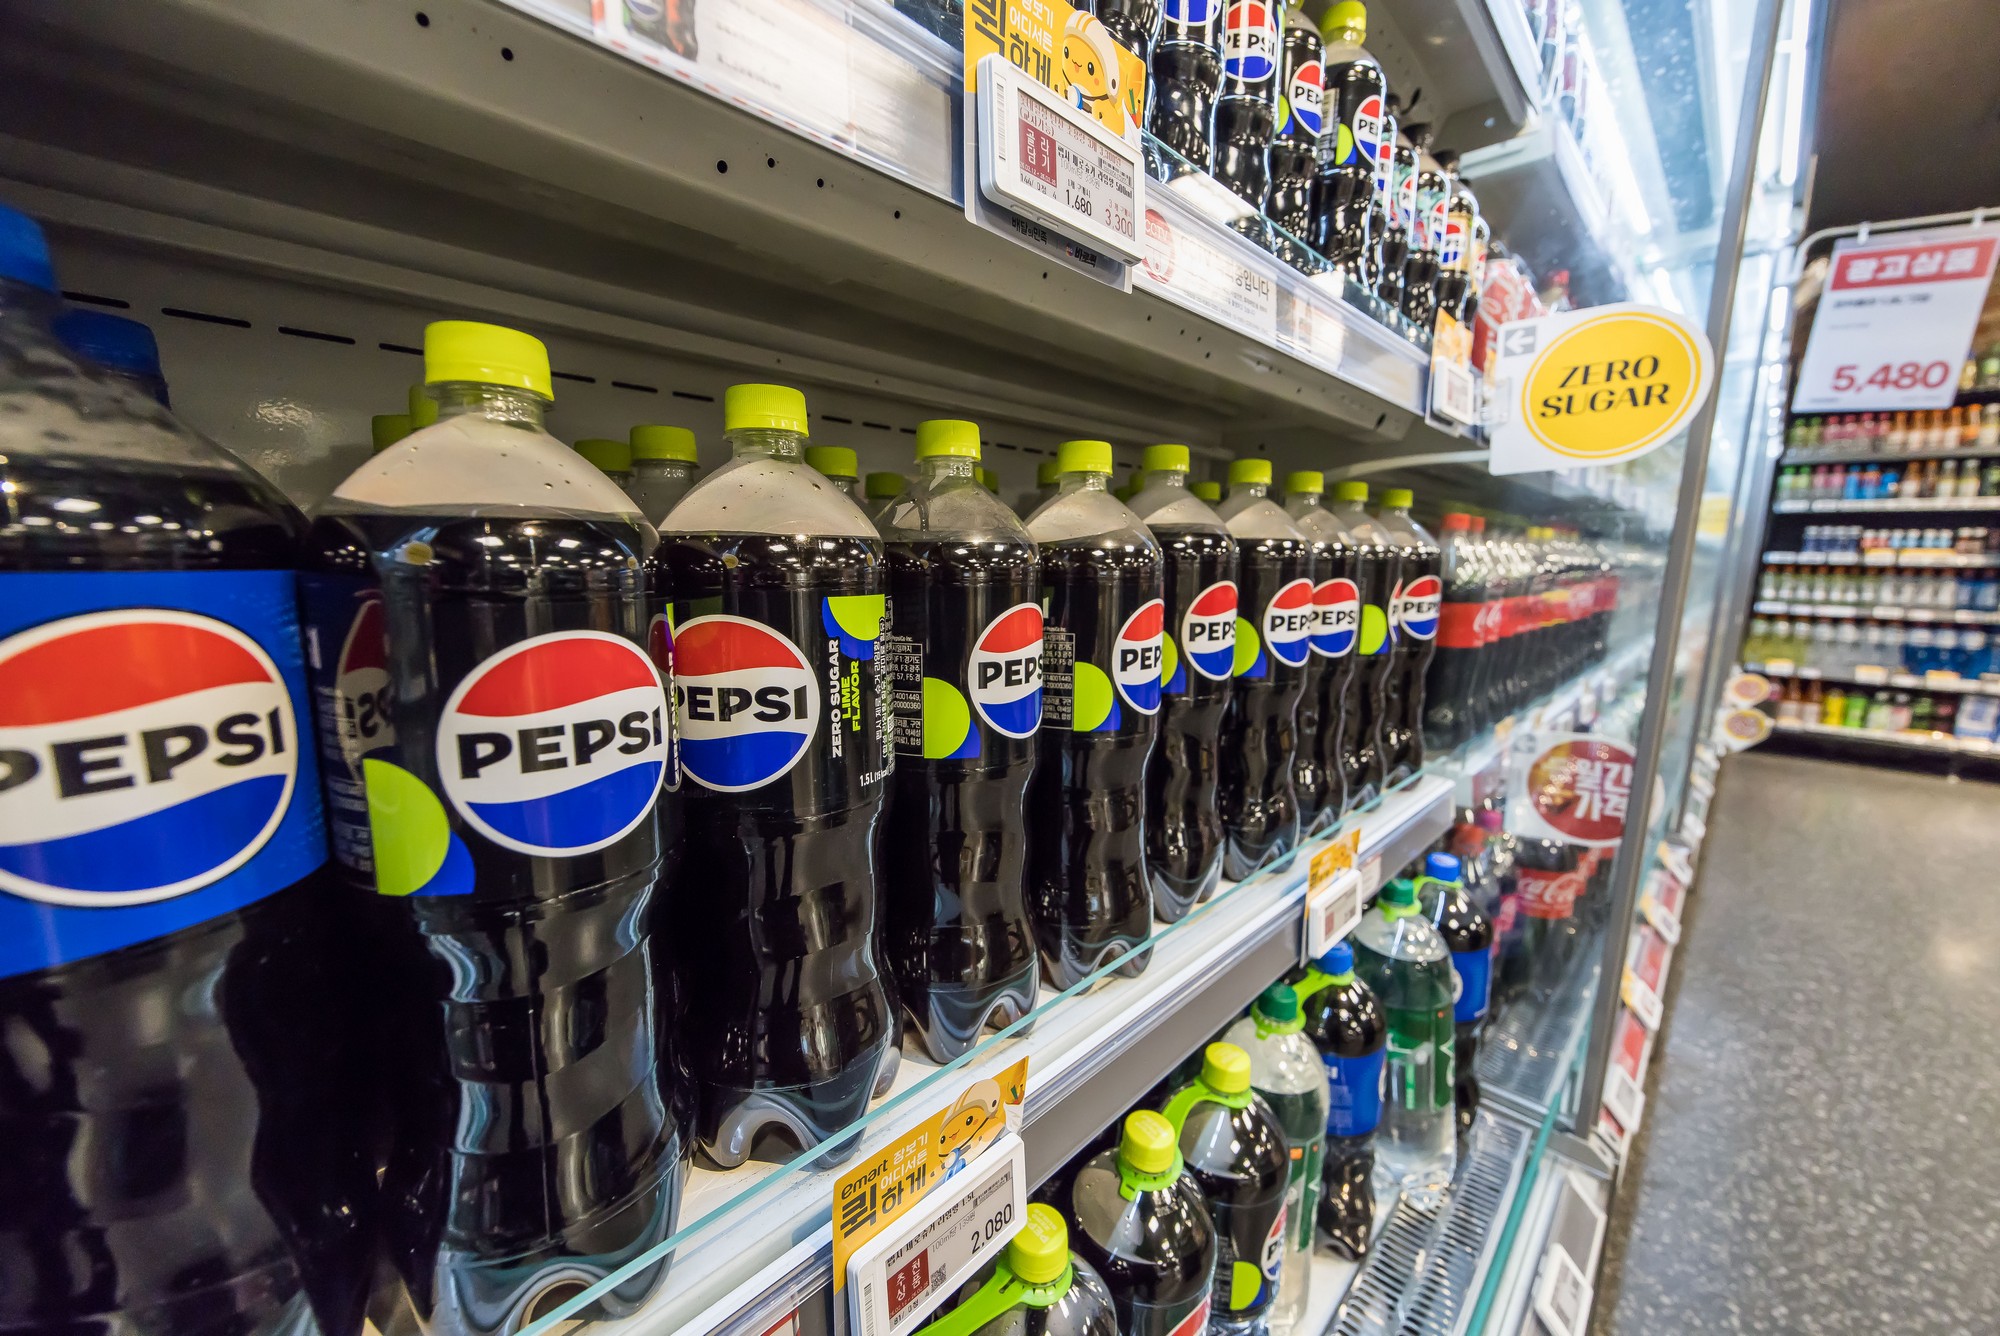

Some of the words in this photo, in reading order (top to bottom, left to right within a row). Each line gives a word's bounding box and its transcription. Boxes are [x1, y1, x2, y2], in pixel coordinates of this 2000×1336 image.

[1009, 6, 1053, 54] 어디서든
[1011, 217, 1048, 246] 배달의민족
[1559, 355, 1660, 389] ZERO
[1830, 360, 1950, 393] 5,480
[1540, 383, 1670, 418] SUGAR
[828, 639, 841, 706] SUGAR
[841, 676, 852, 719] LIME
[850, 660, 861, 732] FLAVOR
[456, 704, 661, 780] PEPSI
[831, 708, 843, 758] ZERO
[1575, 759, 1634, 795] 월간
[893, 1131, 929, 1165] 장보기
[841, 1159, 889, 1200] emart
[880, 1148, 927, 1190] 어디서든
